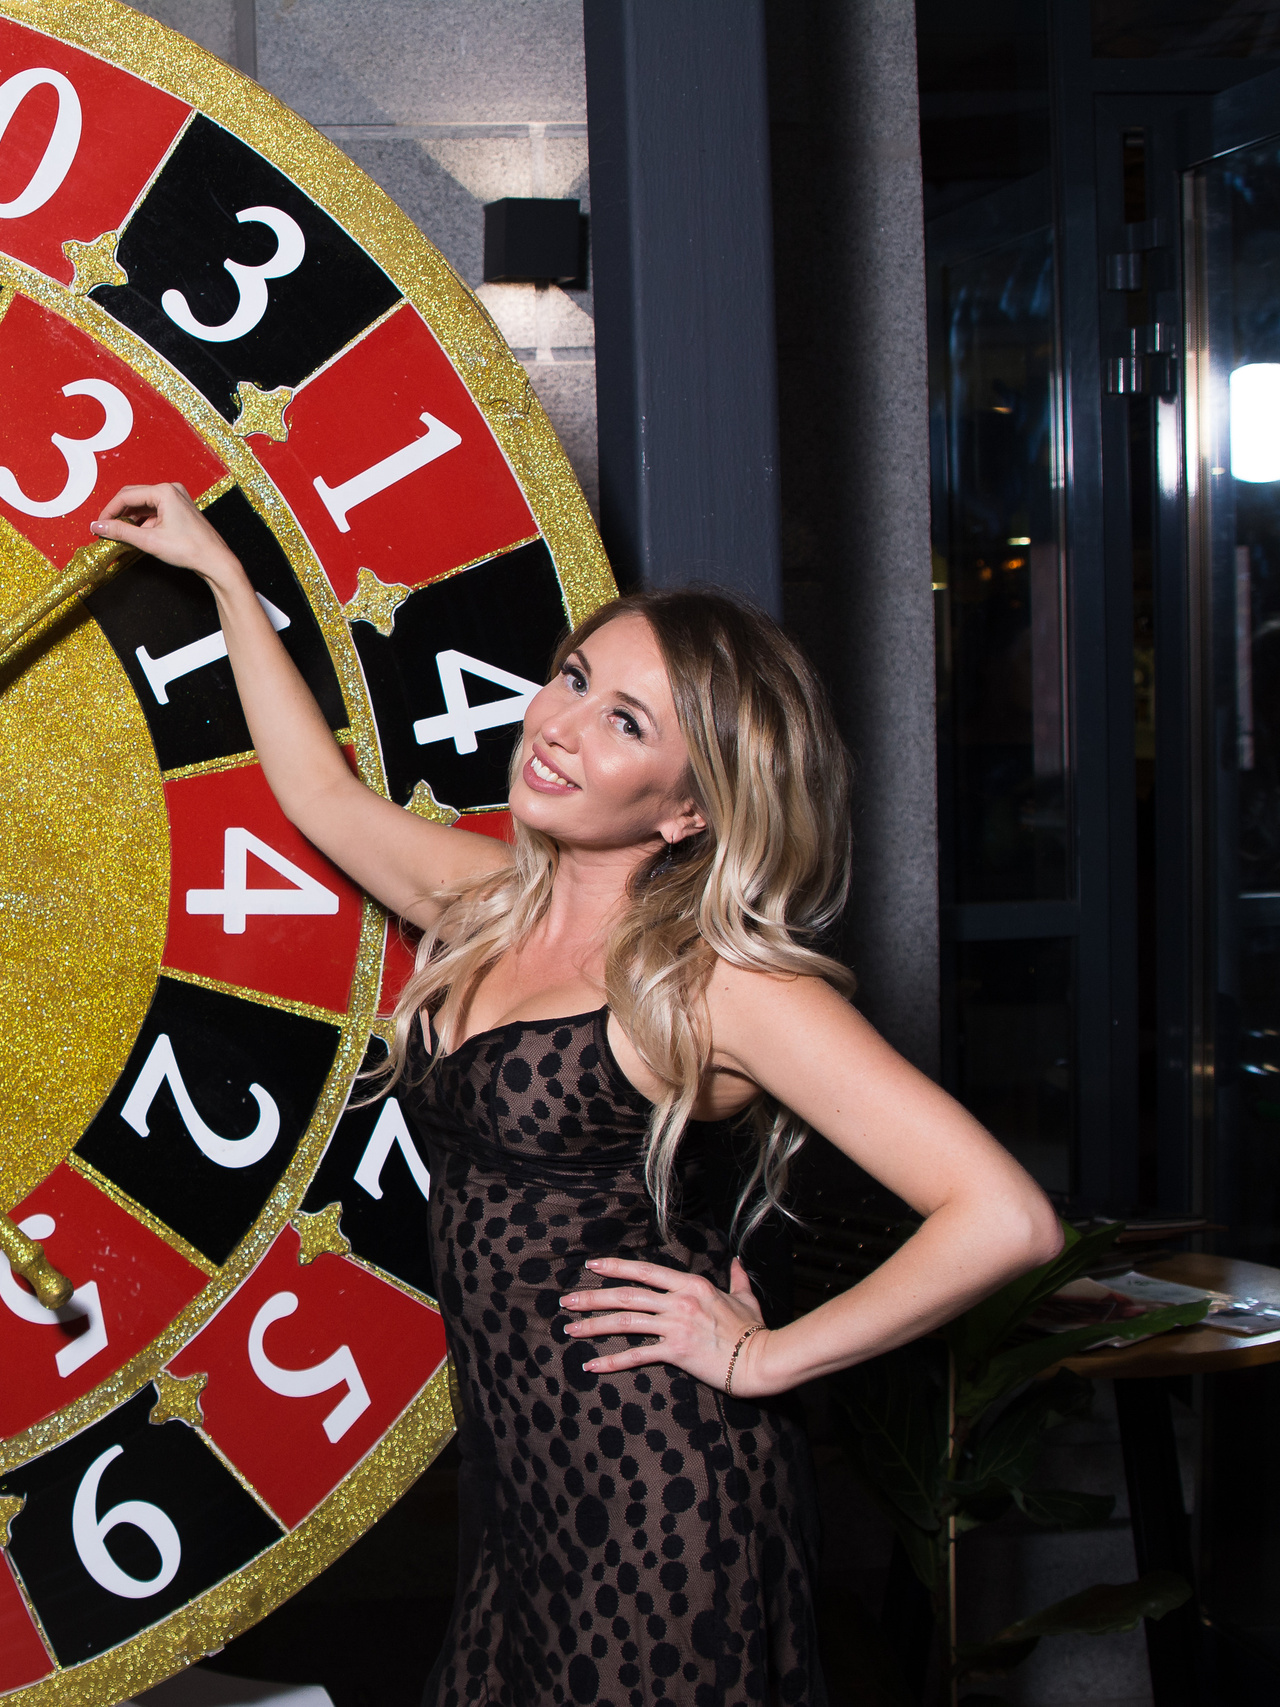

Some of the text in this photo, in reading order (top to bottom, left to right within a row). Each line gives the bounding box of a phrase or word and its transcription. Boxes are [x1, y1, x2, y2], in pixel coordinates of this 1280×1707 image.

[162, 207, 305, 341] 3
[314, 413, 461, 532] 1
[414, 650, 543, 754] 4
[187, 828, 338, 933] 4
[121, 1034, 280, 1167] 2
[249, 1292, 370, 1442] 5
